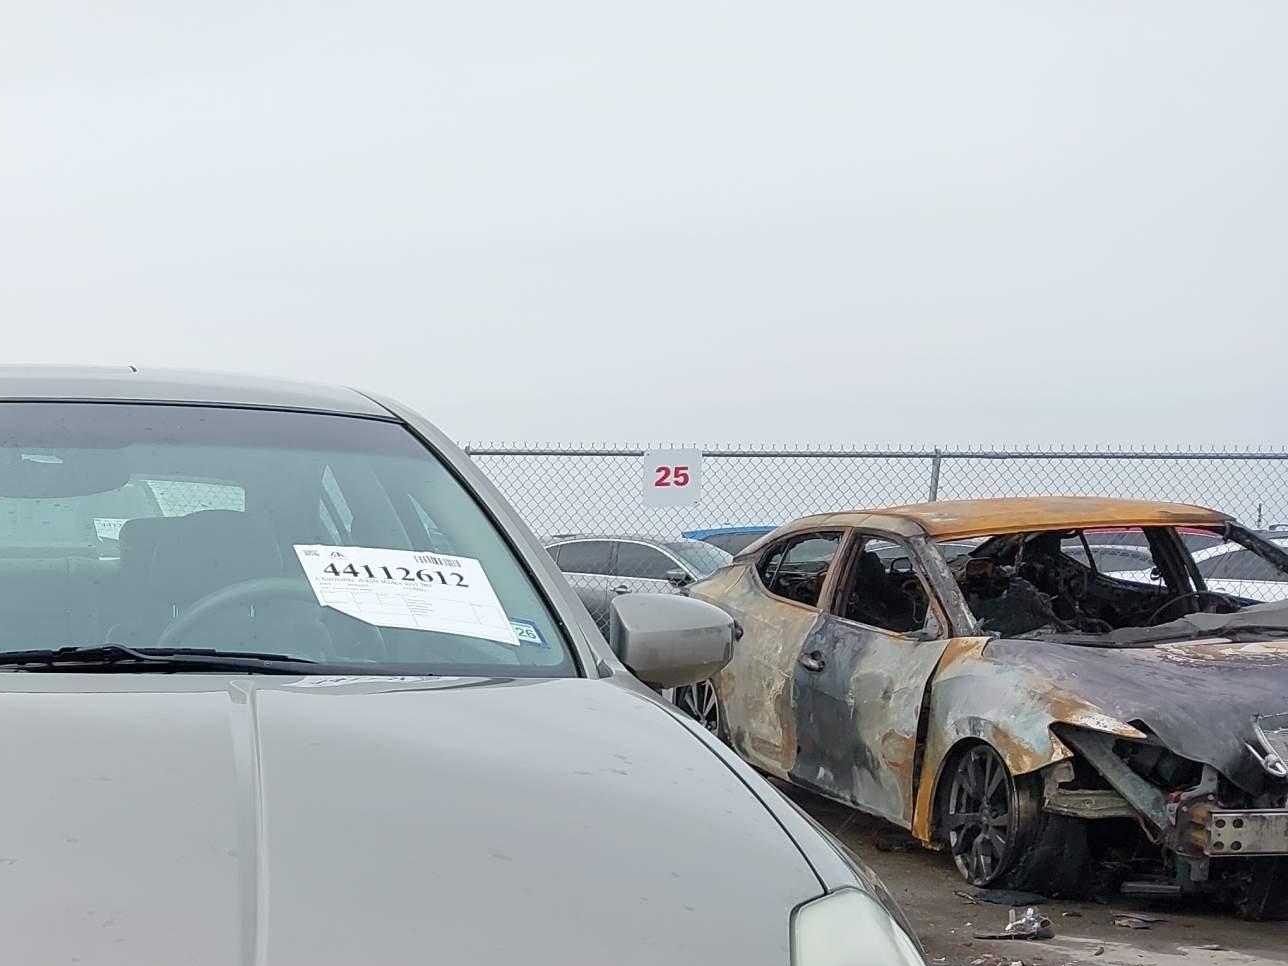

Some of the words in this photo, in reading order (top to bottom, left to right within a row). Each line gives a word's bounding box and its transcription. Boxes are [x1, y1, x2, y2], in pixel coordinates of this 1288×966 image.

[654, 466, 690, 488] 25
[323, 562, 469, 588] 44112612
[515, 627, 537, 640] 26
